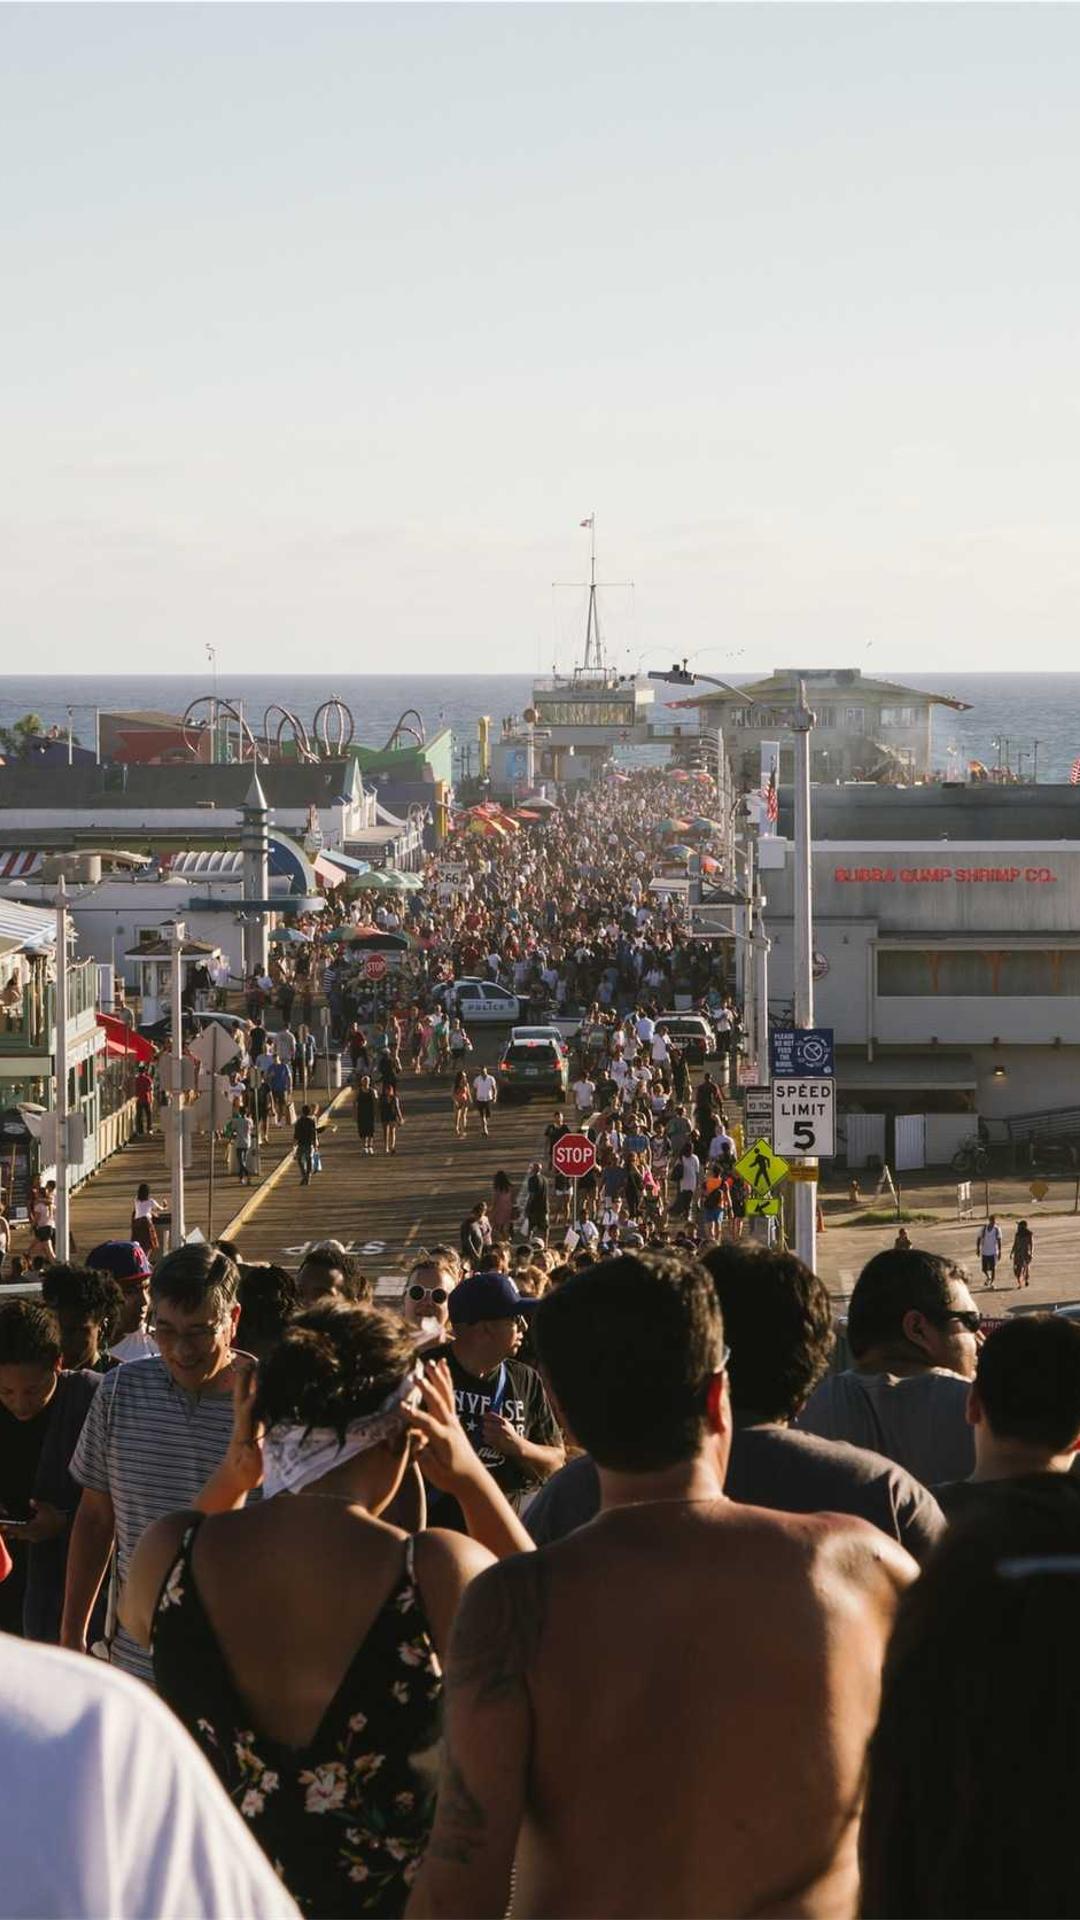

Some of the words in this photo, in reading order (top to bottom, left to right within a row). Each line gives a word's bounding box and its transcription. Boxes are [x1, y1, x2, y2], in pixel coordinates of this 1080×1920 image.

[834, 867, 896, 883] BUBBA
[901, 868, 951, 883] GUMP
[954, 868, 1020, 883] SHRIMP
[1024, 868, 1057, 883] CO.
[367, 961, 385, 972] STOP
[467, 1001, 505, 1011] POLICE
[776, 1085, 831, 1098] SPEED
[781, 1103, 826, 1116] LIMIT
[793, 1121, 816, 1151] 5
[555, 1147, 593, 1163] STOP
[453, 1389, 526, 1421] NVESE
